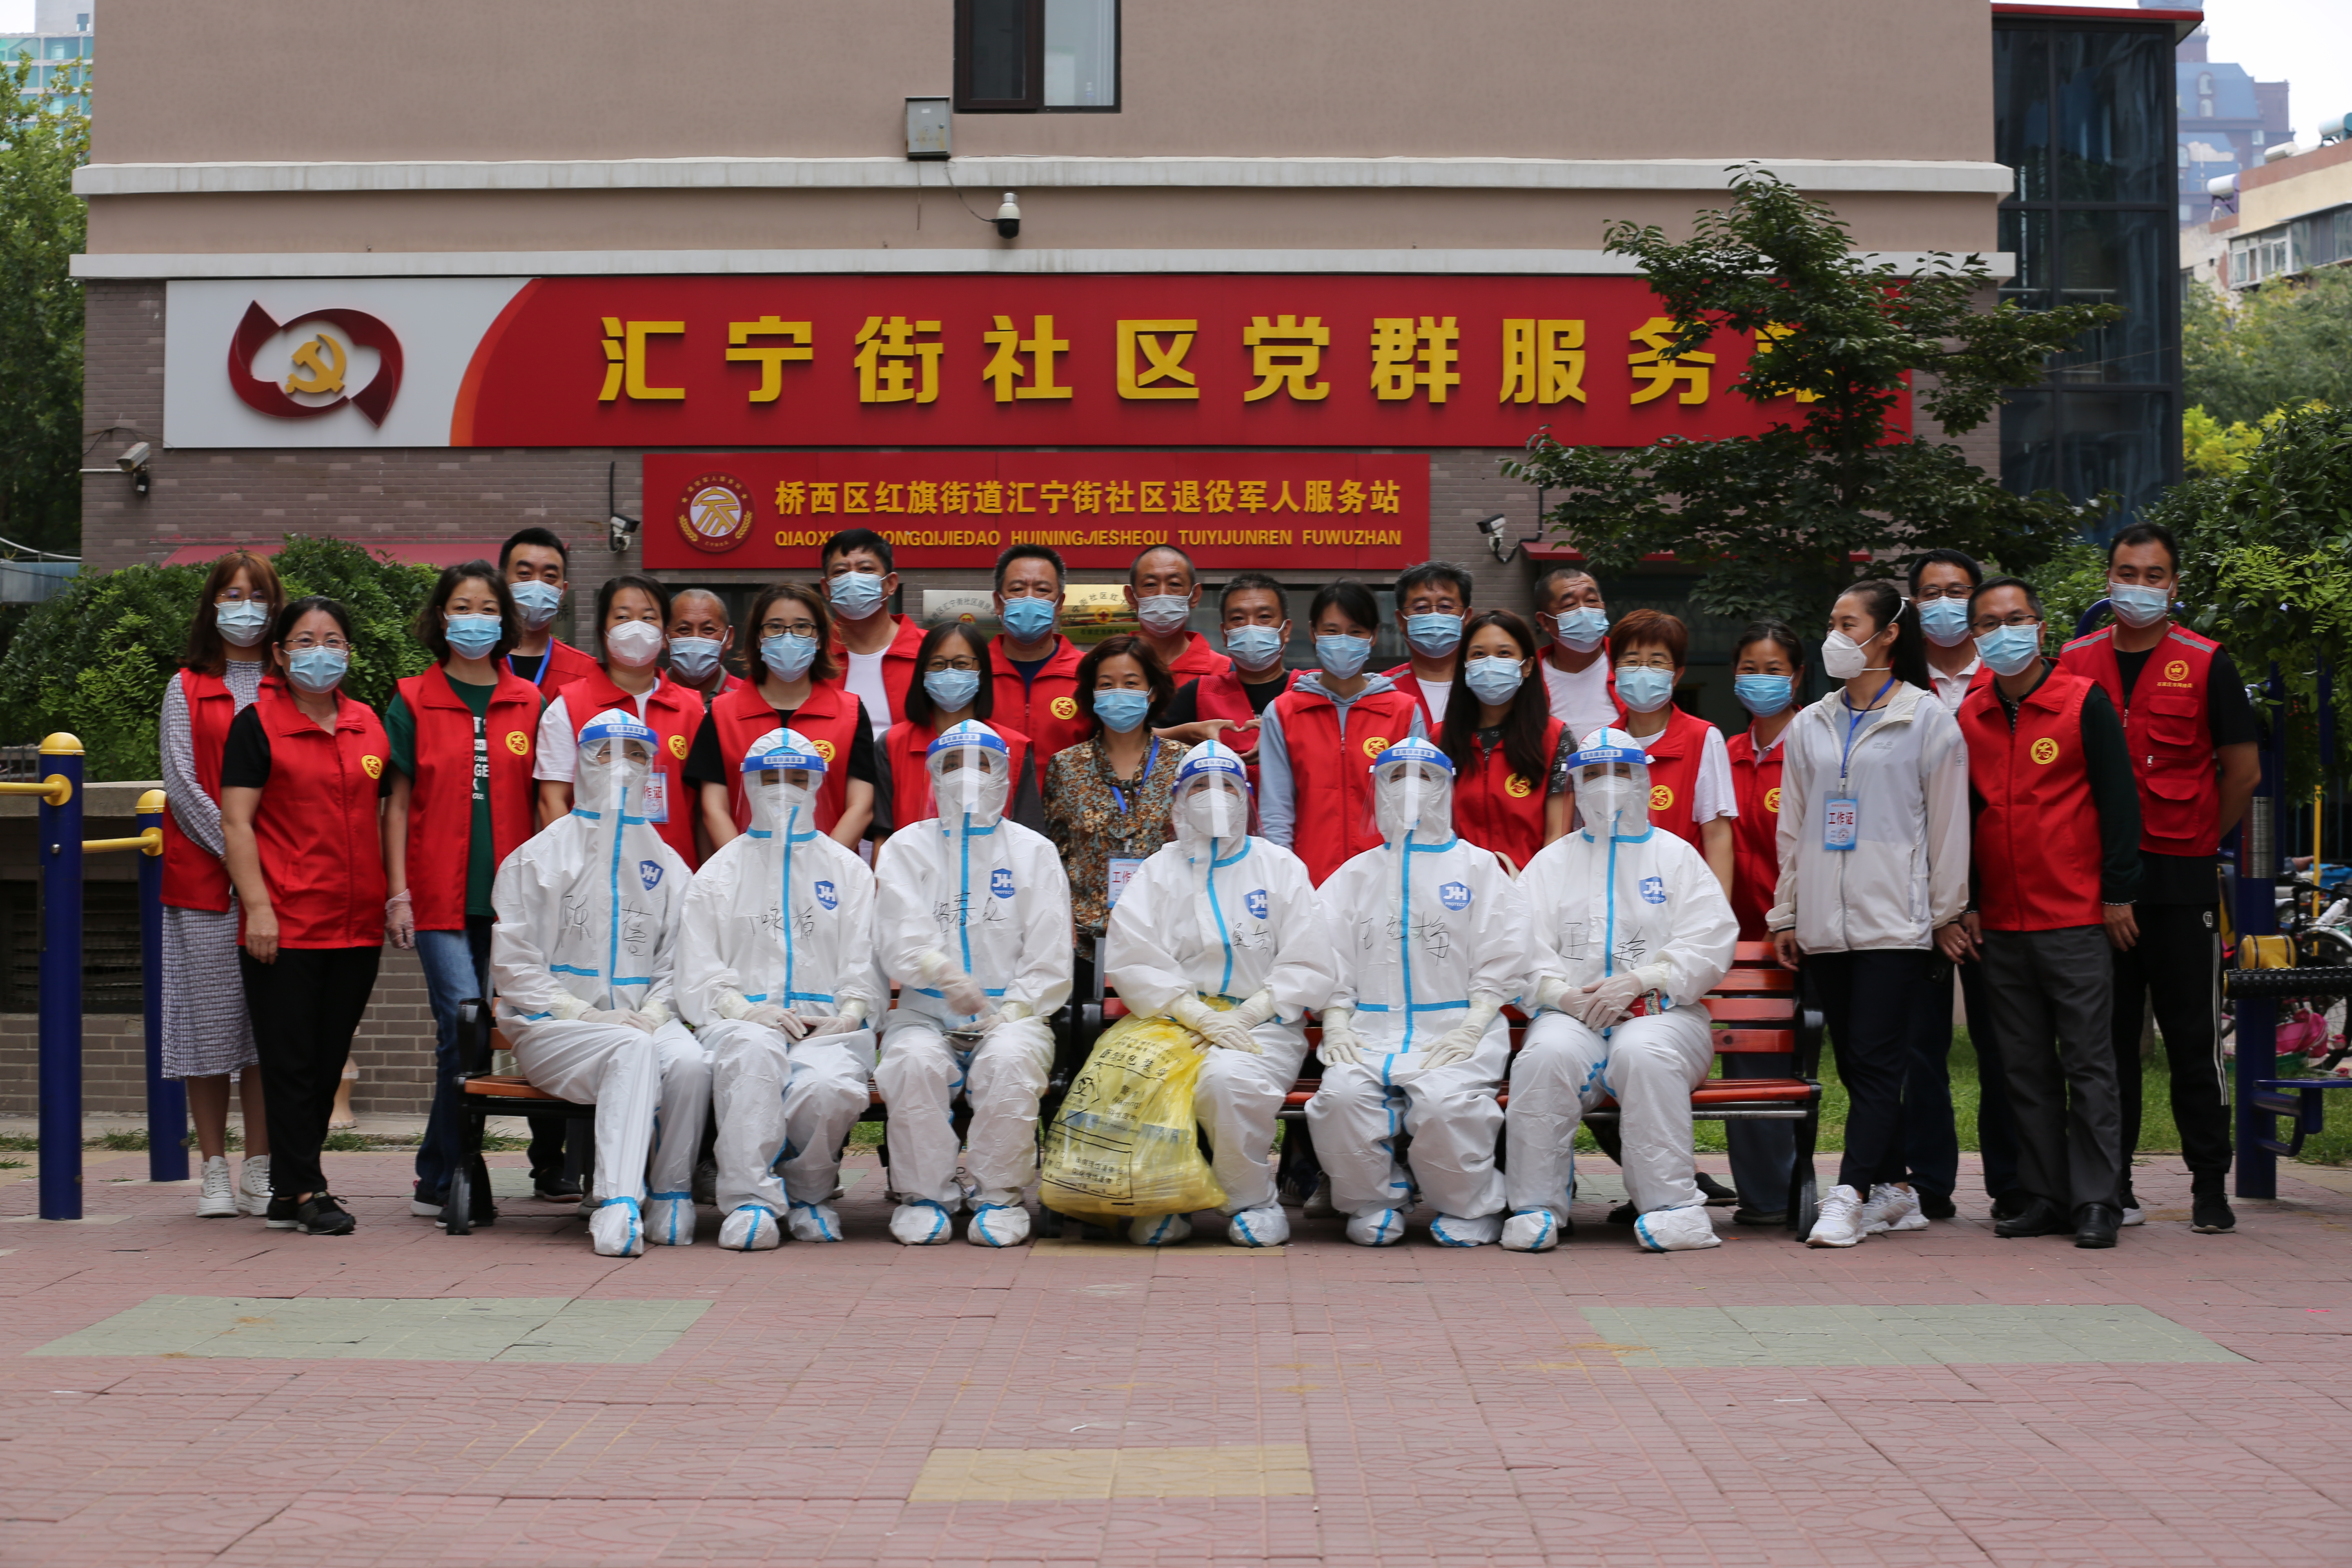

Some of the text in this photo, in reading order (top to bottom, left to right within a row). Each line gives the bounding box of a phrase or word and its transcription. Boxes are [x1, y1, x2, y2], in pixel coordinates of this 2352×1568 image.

[775, 479, 1400, 514] 桥西区红旗街道汇宁街社区退役军人服务站
[872, 530, 1000, 546] ONGQIJIEDAO
[1178, 530, 1292, 545] TUIYIJUNREN
[1303, 530, 1401, 545] FUWUZHAN
[1828, 811, 1853, 825] 工作证
[1112, 871, 1136, 884] 工作
